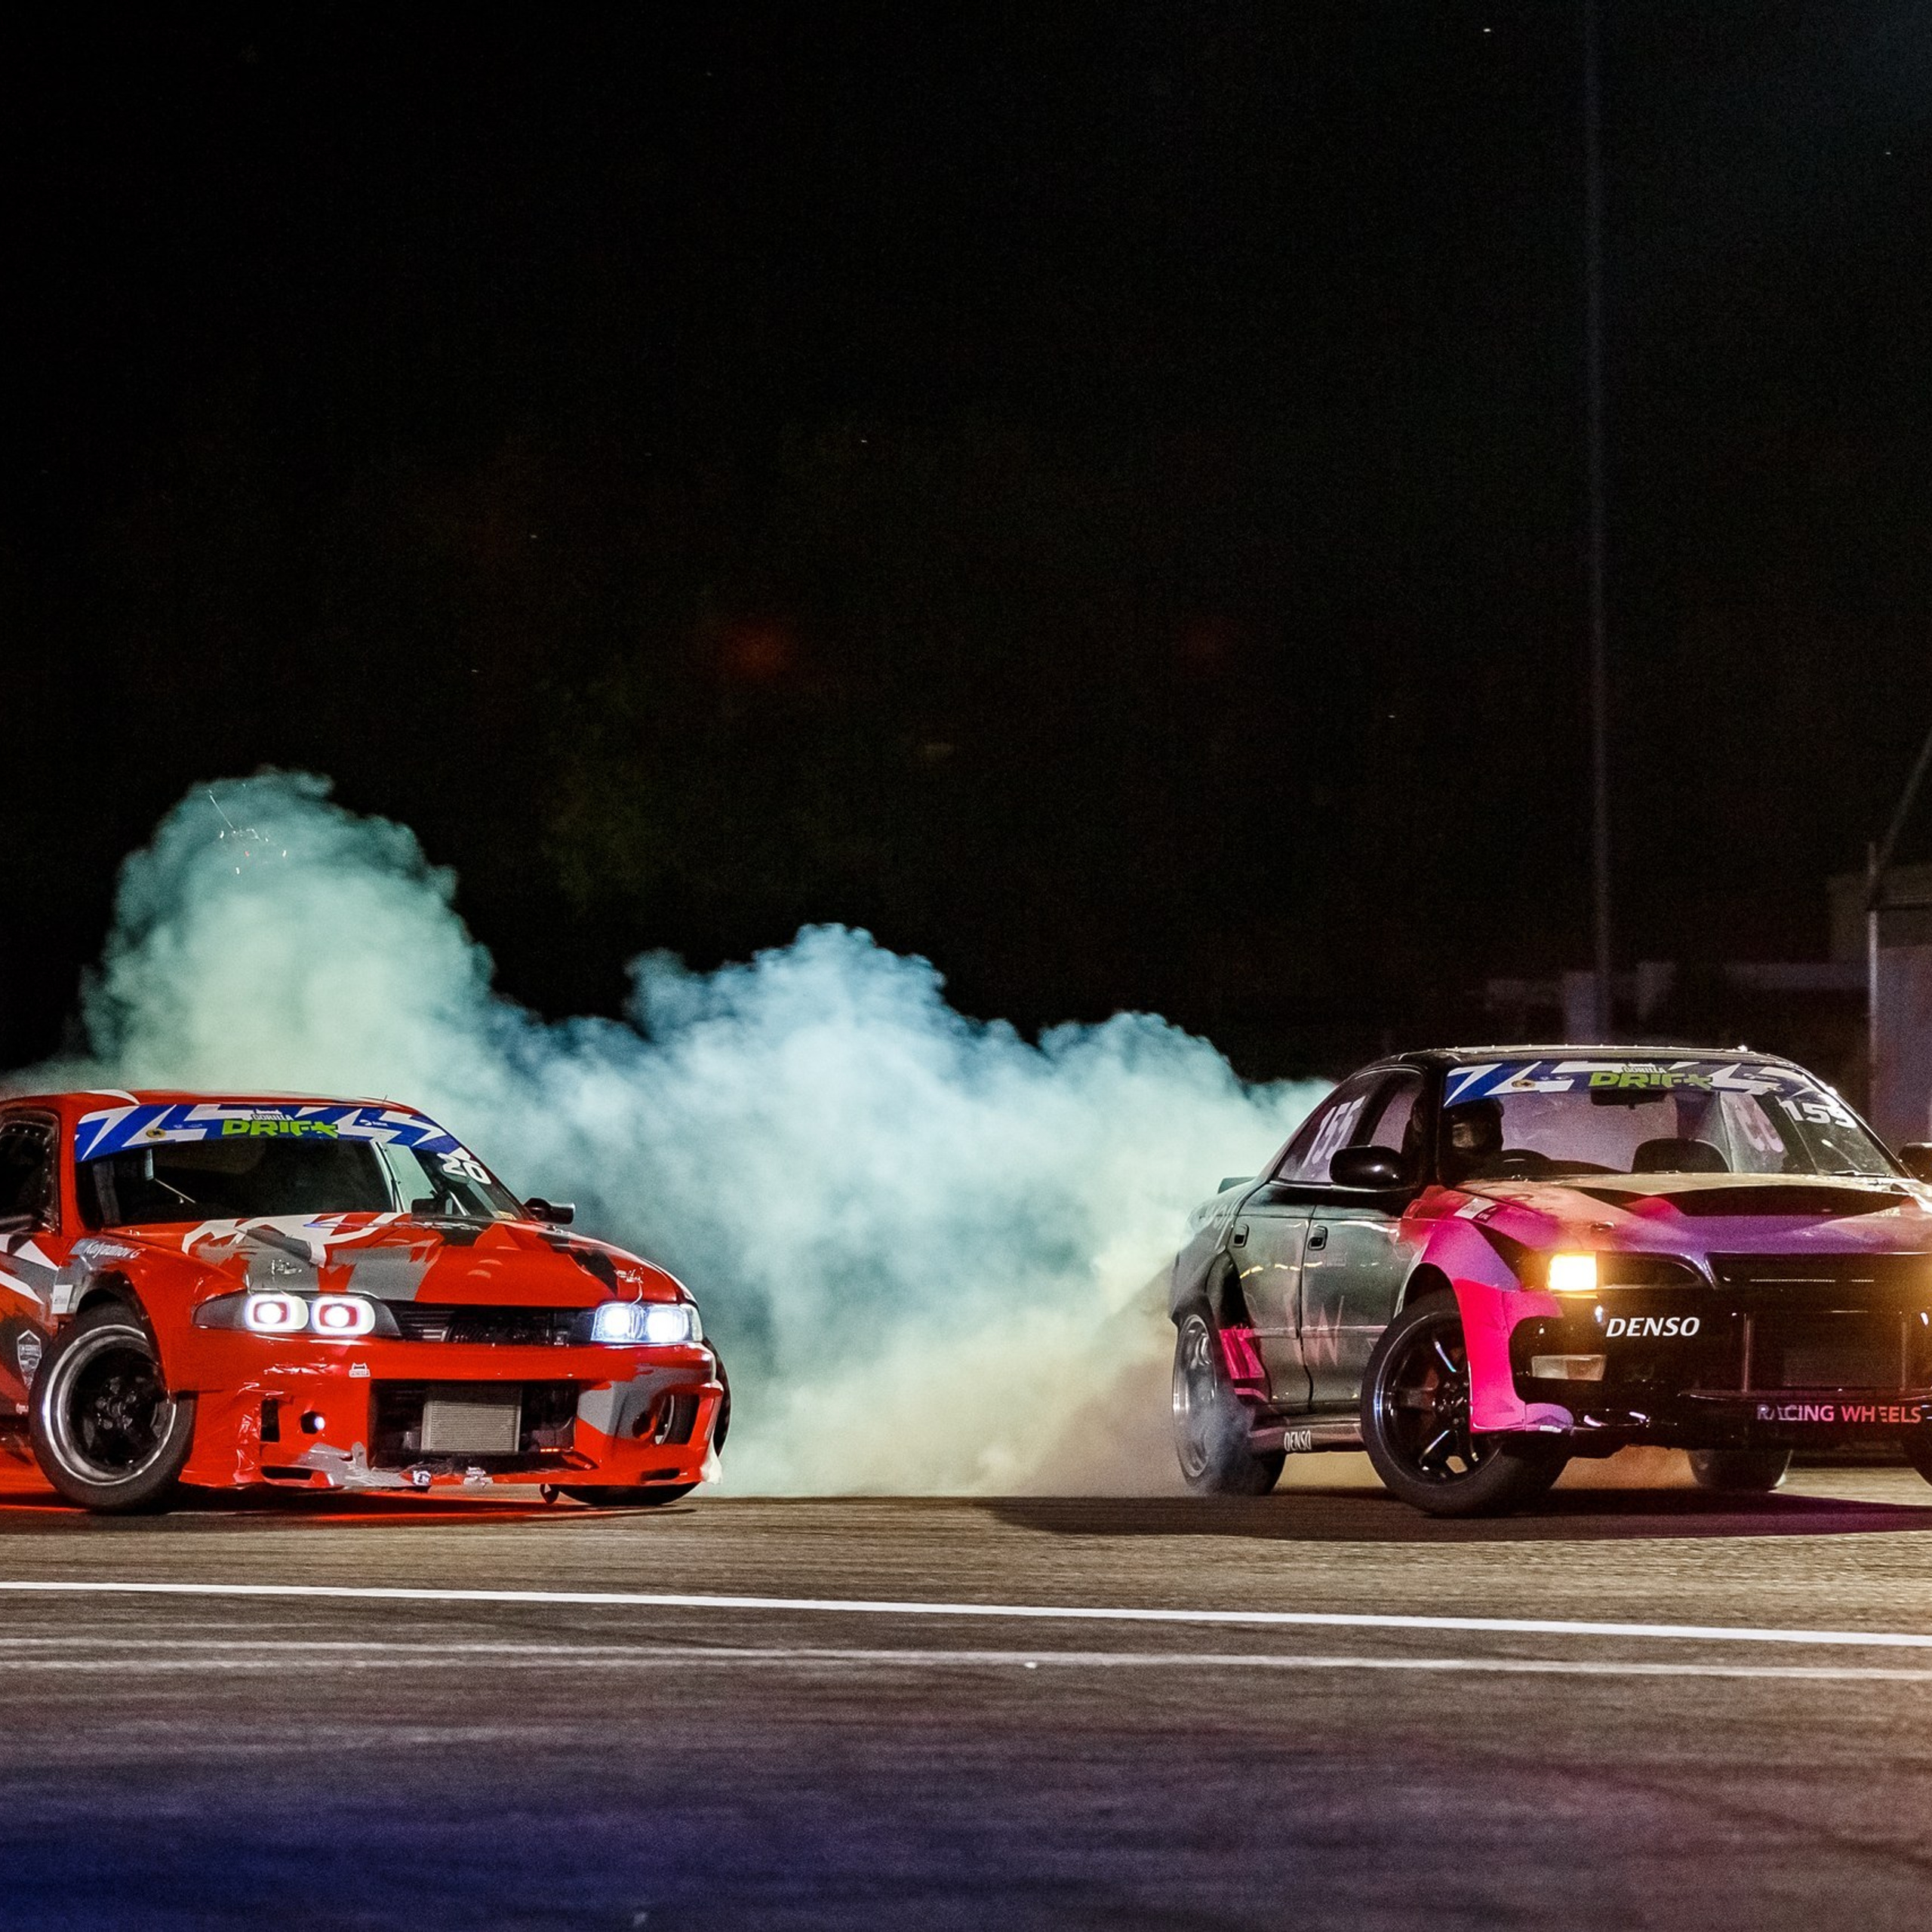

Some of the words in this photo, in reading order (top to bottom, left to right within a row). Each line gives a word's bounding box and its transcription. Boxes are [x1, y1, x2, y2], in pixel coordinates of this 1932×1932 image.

[1779, 1099, 1857, 1128] 155
[1301, 1095, 1366, 1169] 155
[437, 1152, 492, 1185] 20
[1605, 1316, 1700, 1337] DENSO
[1756, 1404, 1835, 1422] RACING
[1841, 1405, 1922, 1424] WHEELS
[1284, 1429, 1312, 1452] DENSO
